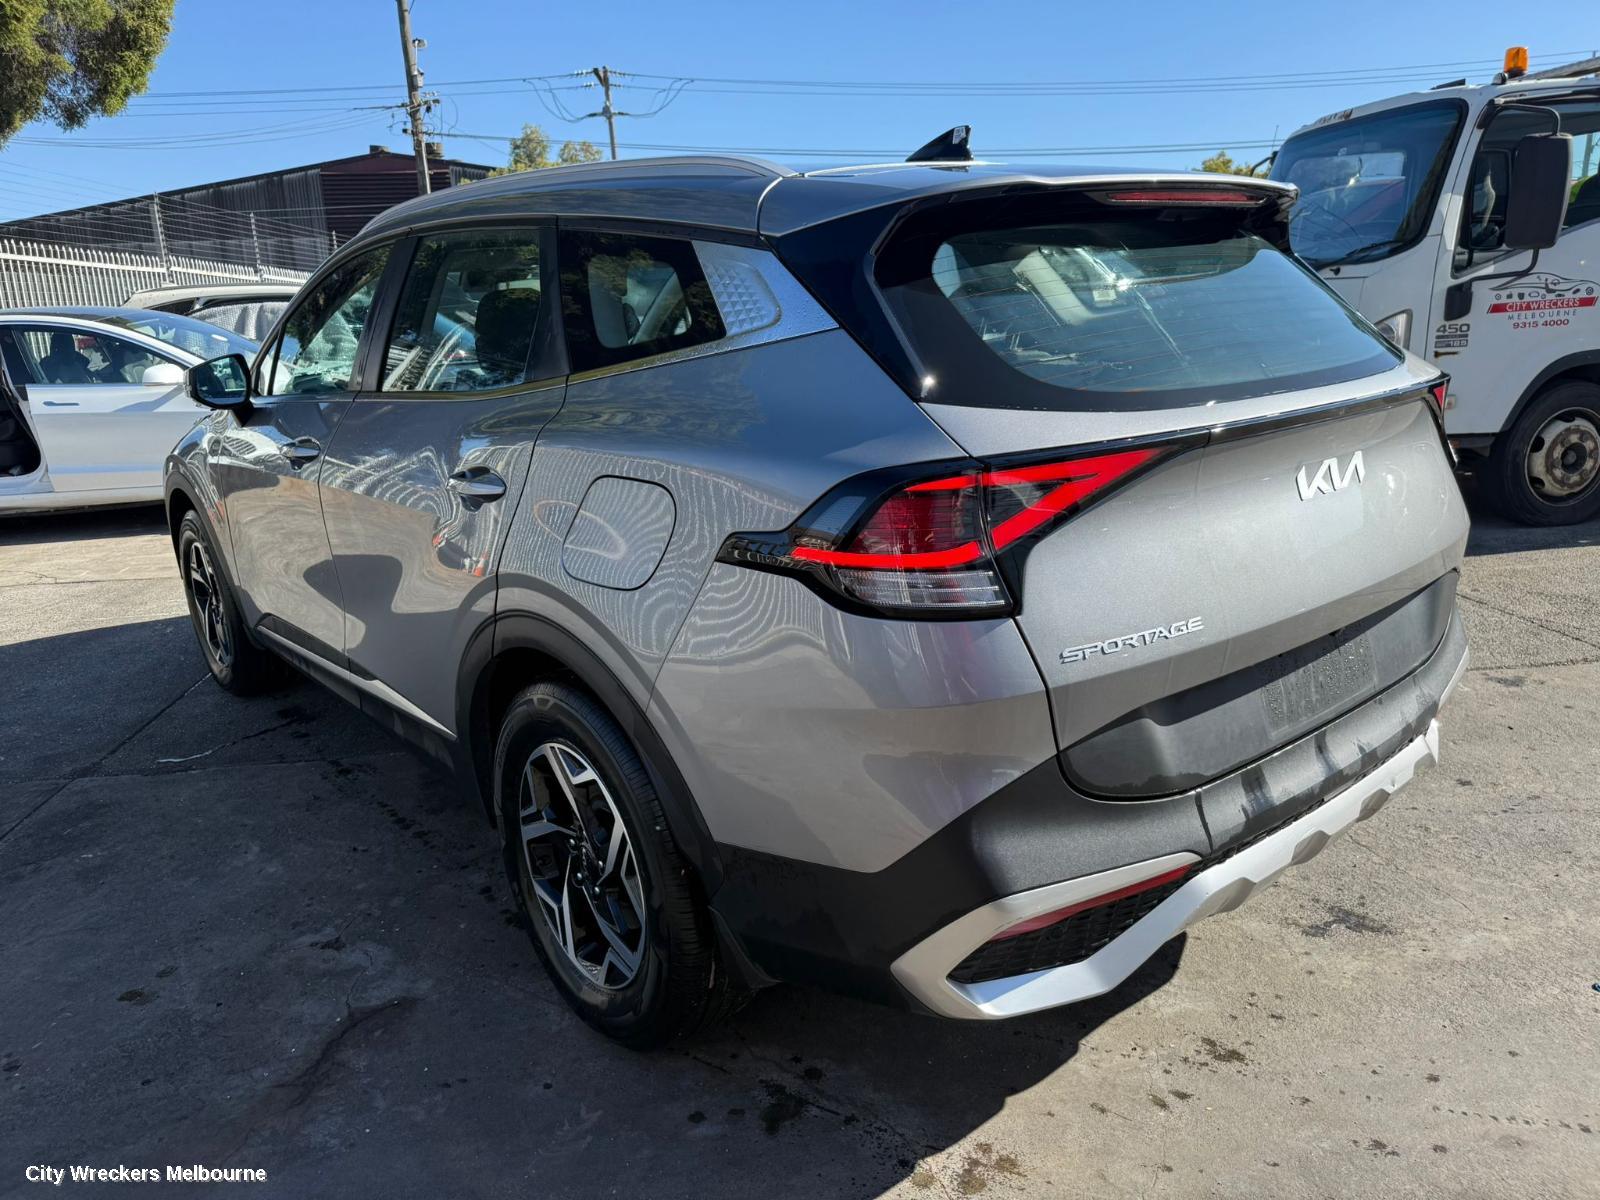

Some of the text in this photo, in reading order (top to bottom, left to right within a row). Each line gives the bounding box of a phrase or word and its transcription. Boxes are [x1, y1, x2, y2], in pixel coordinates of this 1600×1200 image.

[1506, 298, 1580, 312] CITY WRECKERS
[1507, 309, 1577, 321] MELBOURNE
[1436, 323, 1470, 334] 450
[1512, 318, 1570, 329] 9315 4000
[1296, 450, 1366, 501] KIA
[1059, 616, 1205, 664] SPORTAGE
